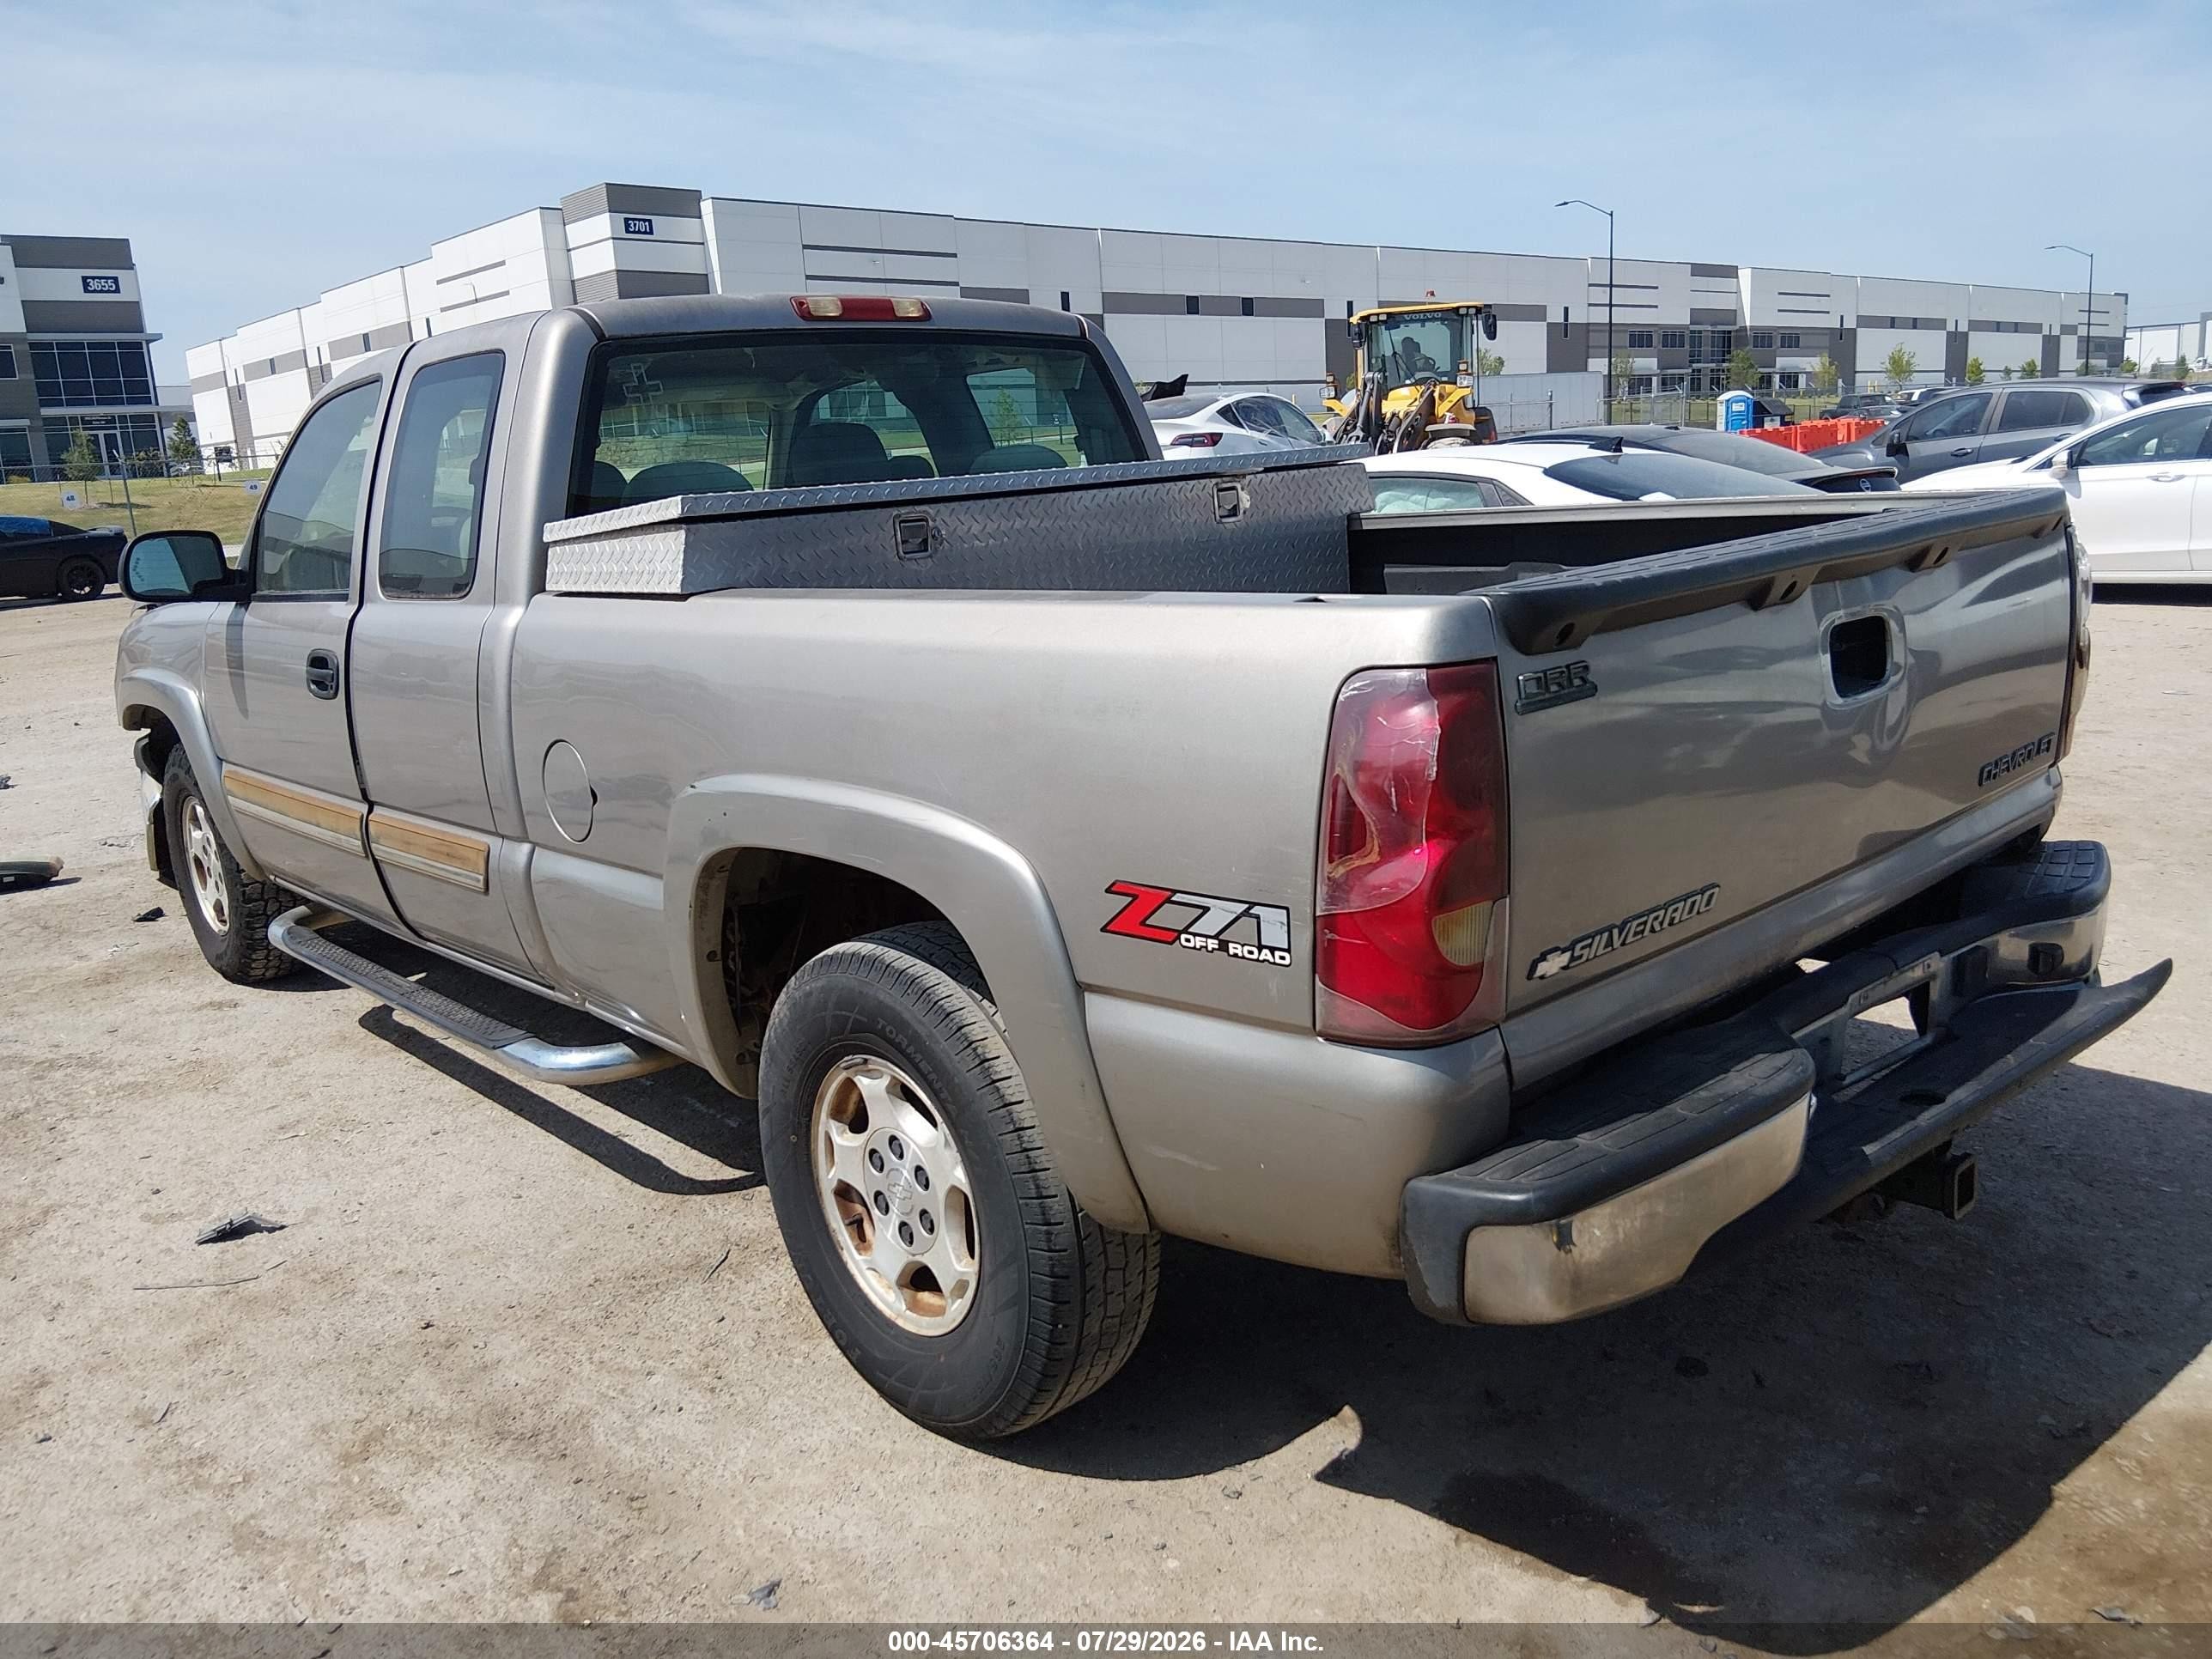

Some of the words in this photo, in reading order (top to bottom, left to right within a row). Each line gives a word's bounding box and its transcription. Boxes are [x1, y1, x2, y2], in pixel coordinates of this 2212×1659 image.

[628, 220, 650, 233] 3701
[86, 278, 116, 291] 3655
[1404, 312, 1442, 321] VOLVO
[1103, 881, 1290, 949] Z71
[1568, 884, 1720, 968] SILVERADO
[1180, 933, 1219, 952] OFF
[1228, 942, 1291, 967] ROAD
